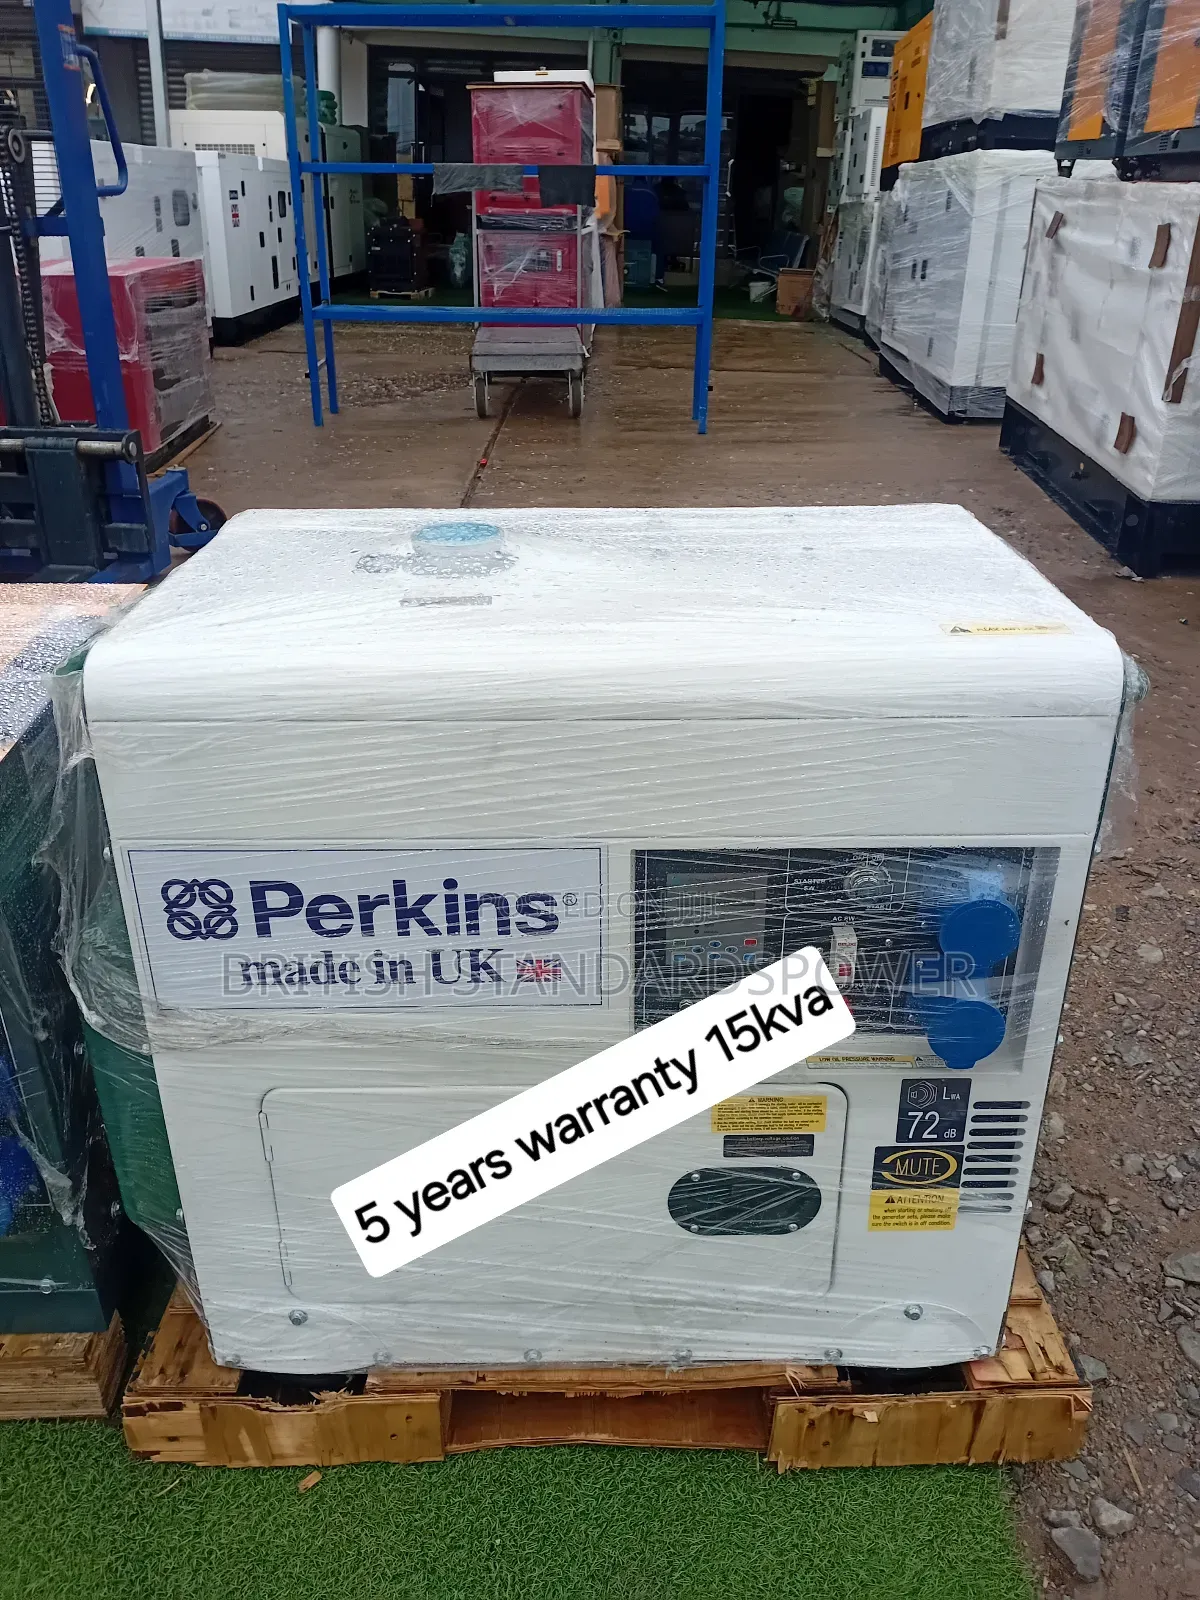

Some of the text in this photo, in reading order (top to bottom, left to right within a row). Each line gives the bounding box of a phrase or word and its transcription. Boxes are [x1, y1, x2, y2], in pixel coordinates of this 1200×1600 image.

[238, 948, 506, 986] made in UK
[907, 1110, 957, 1139] 72 dB
[895, 1157, 944, 1176] MUTE
[896, 1194, 945, 1204] ATTENTION
